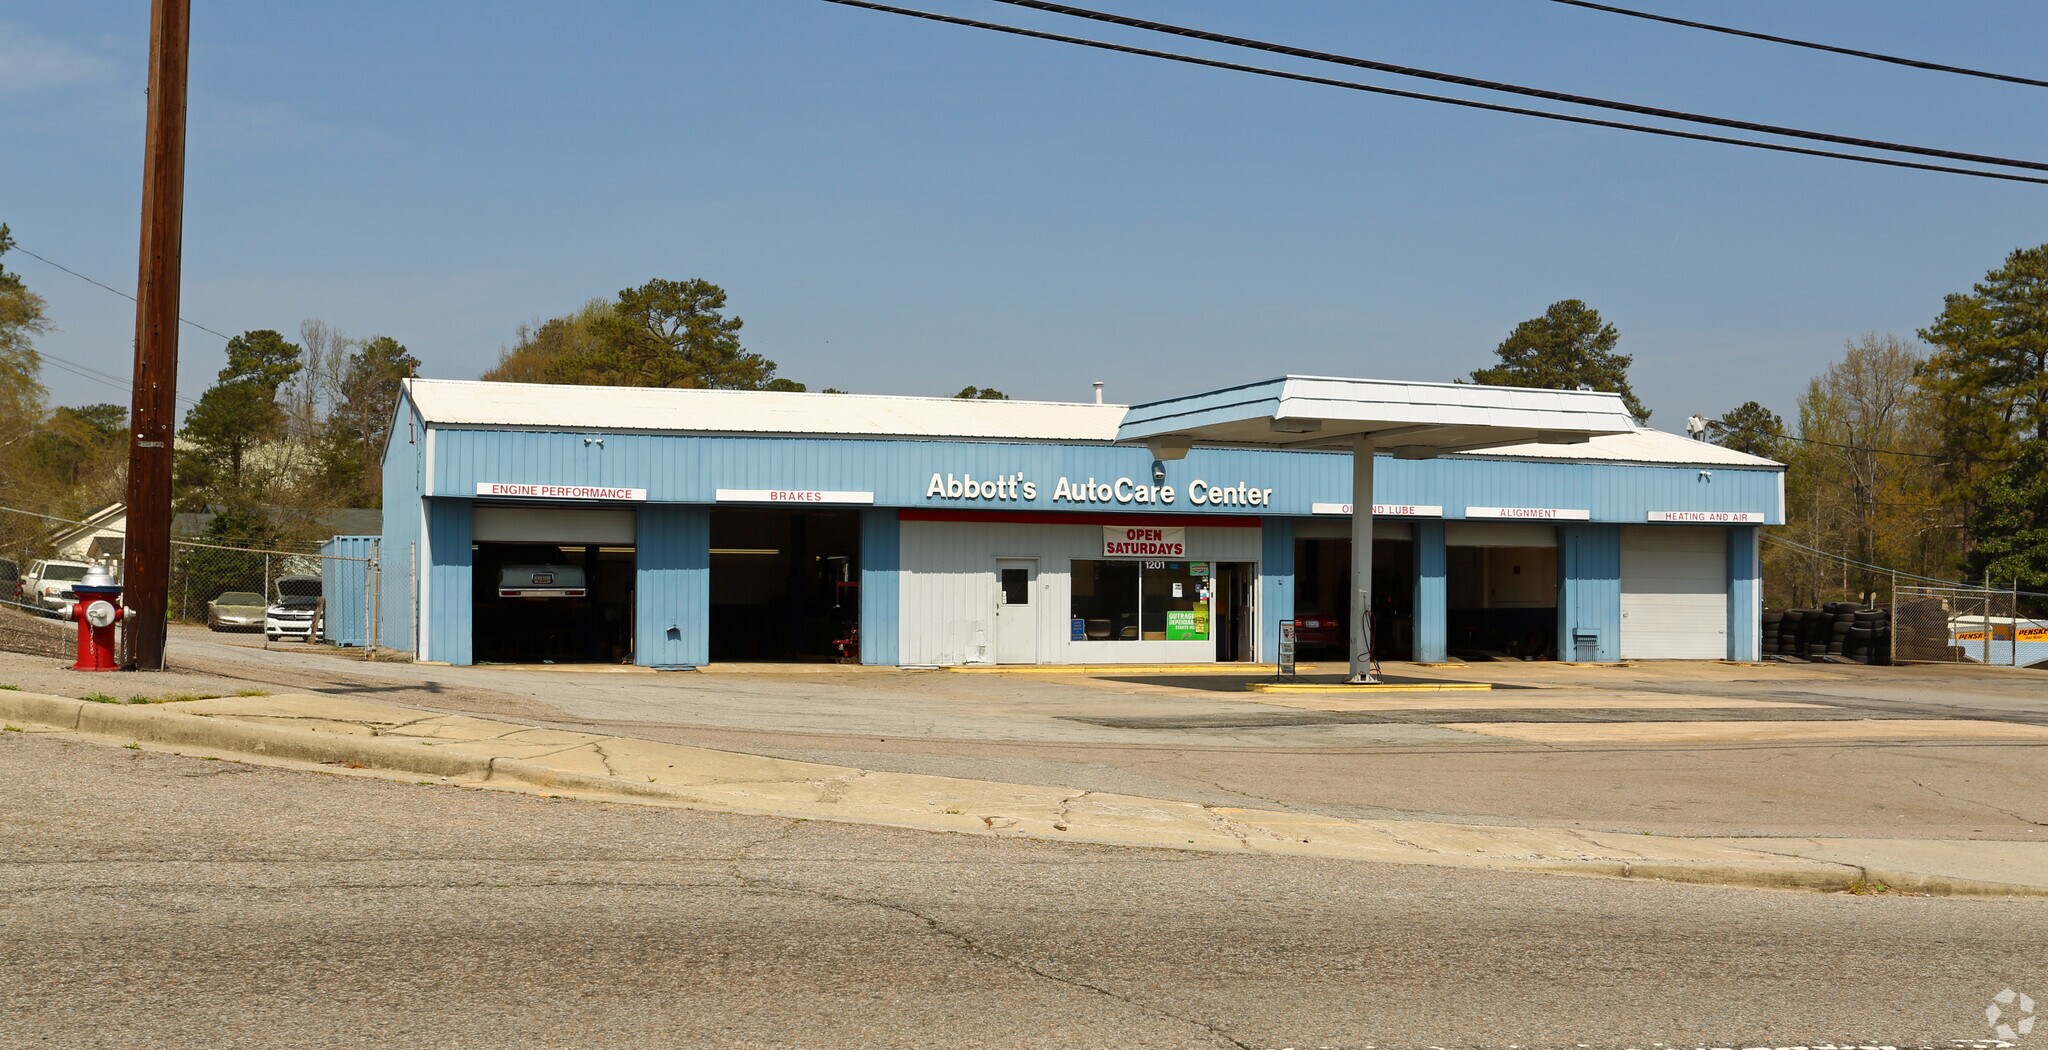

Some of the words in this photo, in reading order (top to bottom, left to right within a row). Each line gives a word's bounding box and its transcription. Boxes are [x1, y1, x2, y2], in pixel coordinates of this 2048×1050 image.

[492, 484, 538, 496] ENGINE
[541, 486, 632, 499] PERFORMANCE
[926, 472, 1037, 501] Abbott's
[1053, 477, 1175, 504] AutoCare
[1188, 479, 1272, 506] Center
[770, 491, 821, 501] BRAKES
[1342, 505, 1353, 514] OI
[1372, 506, 1385, 514] ND
[1389, 506, 1415, 515] LUBE
[1500, 509, 1557, 518] ALIGNMENT
[1665, 512, 1705, 521] HEATING
[1709, 513, 1729, 521] AND
[1733, 513, 1748, 522] AIR
[1126, 528, 1162, 541] OPEN
[1107, 542, 1183, 555] SATURDAYS
[1145, 561, 1165, 570] 1201
